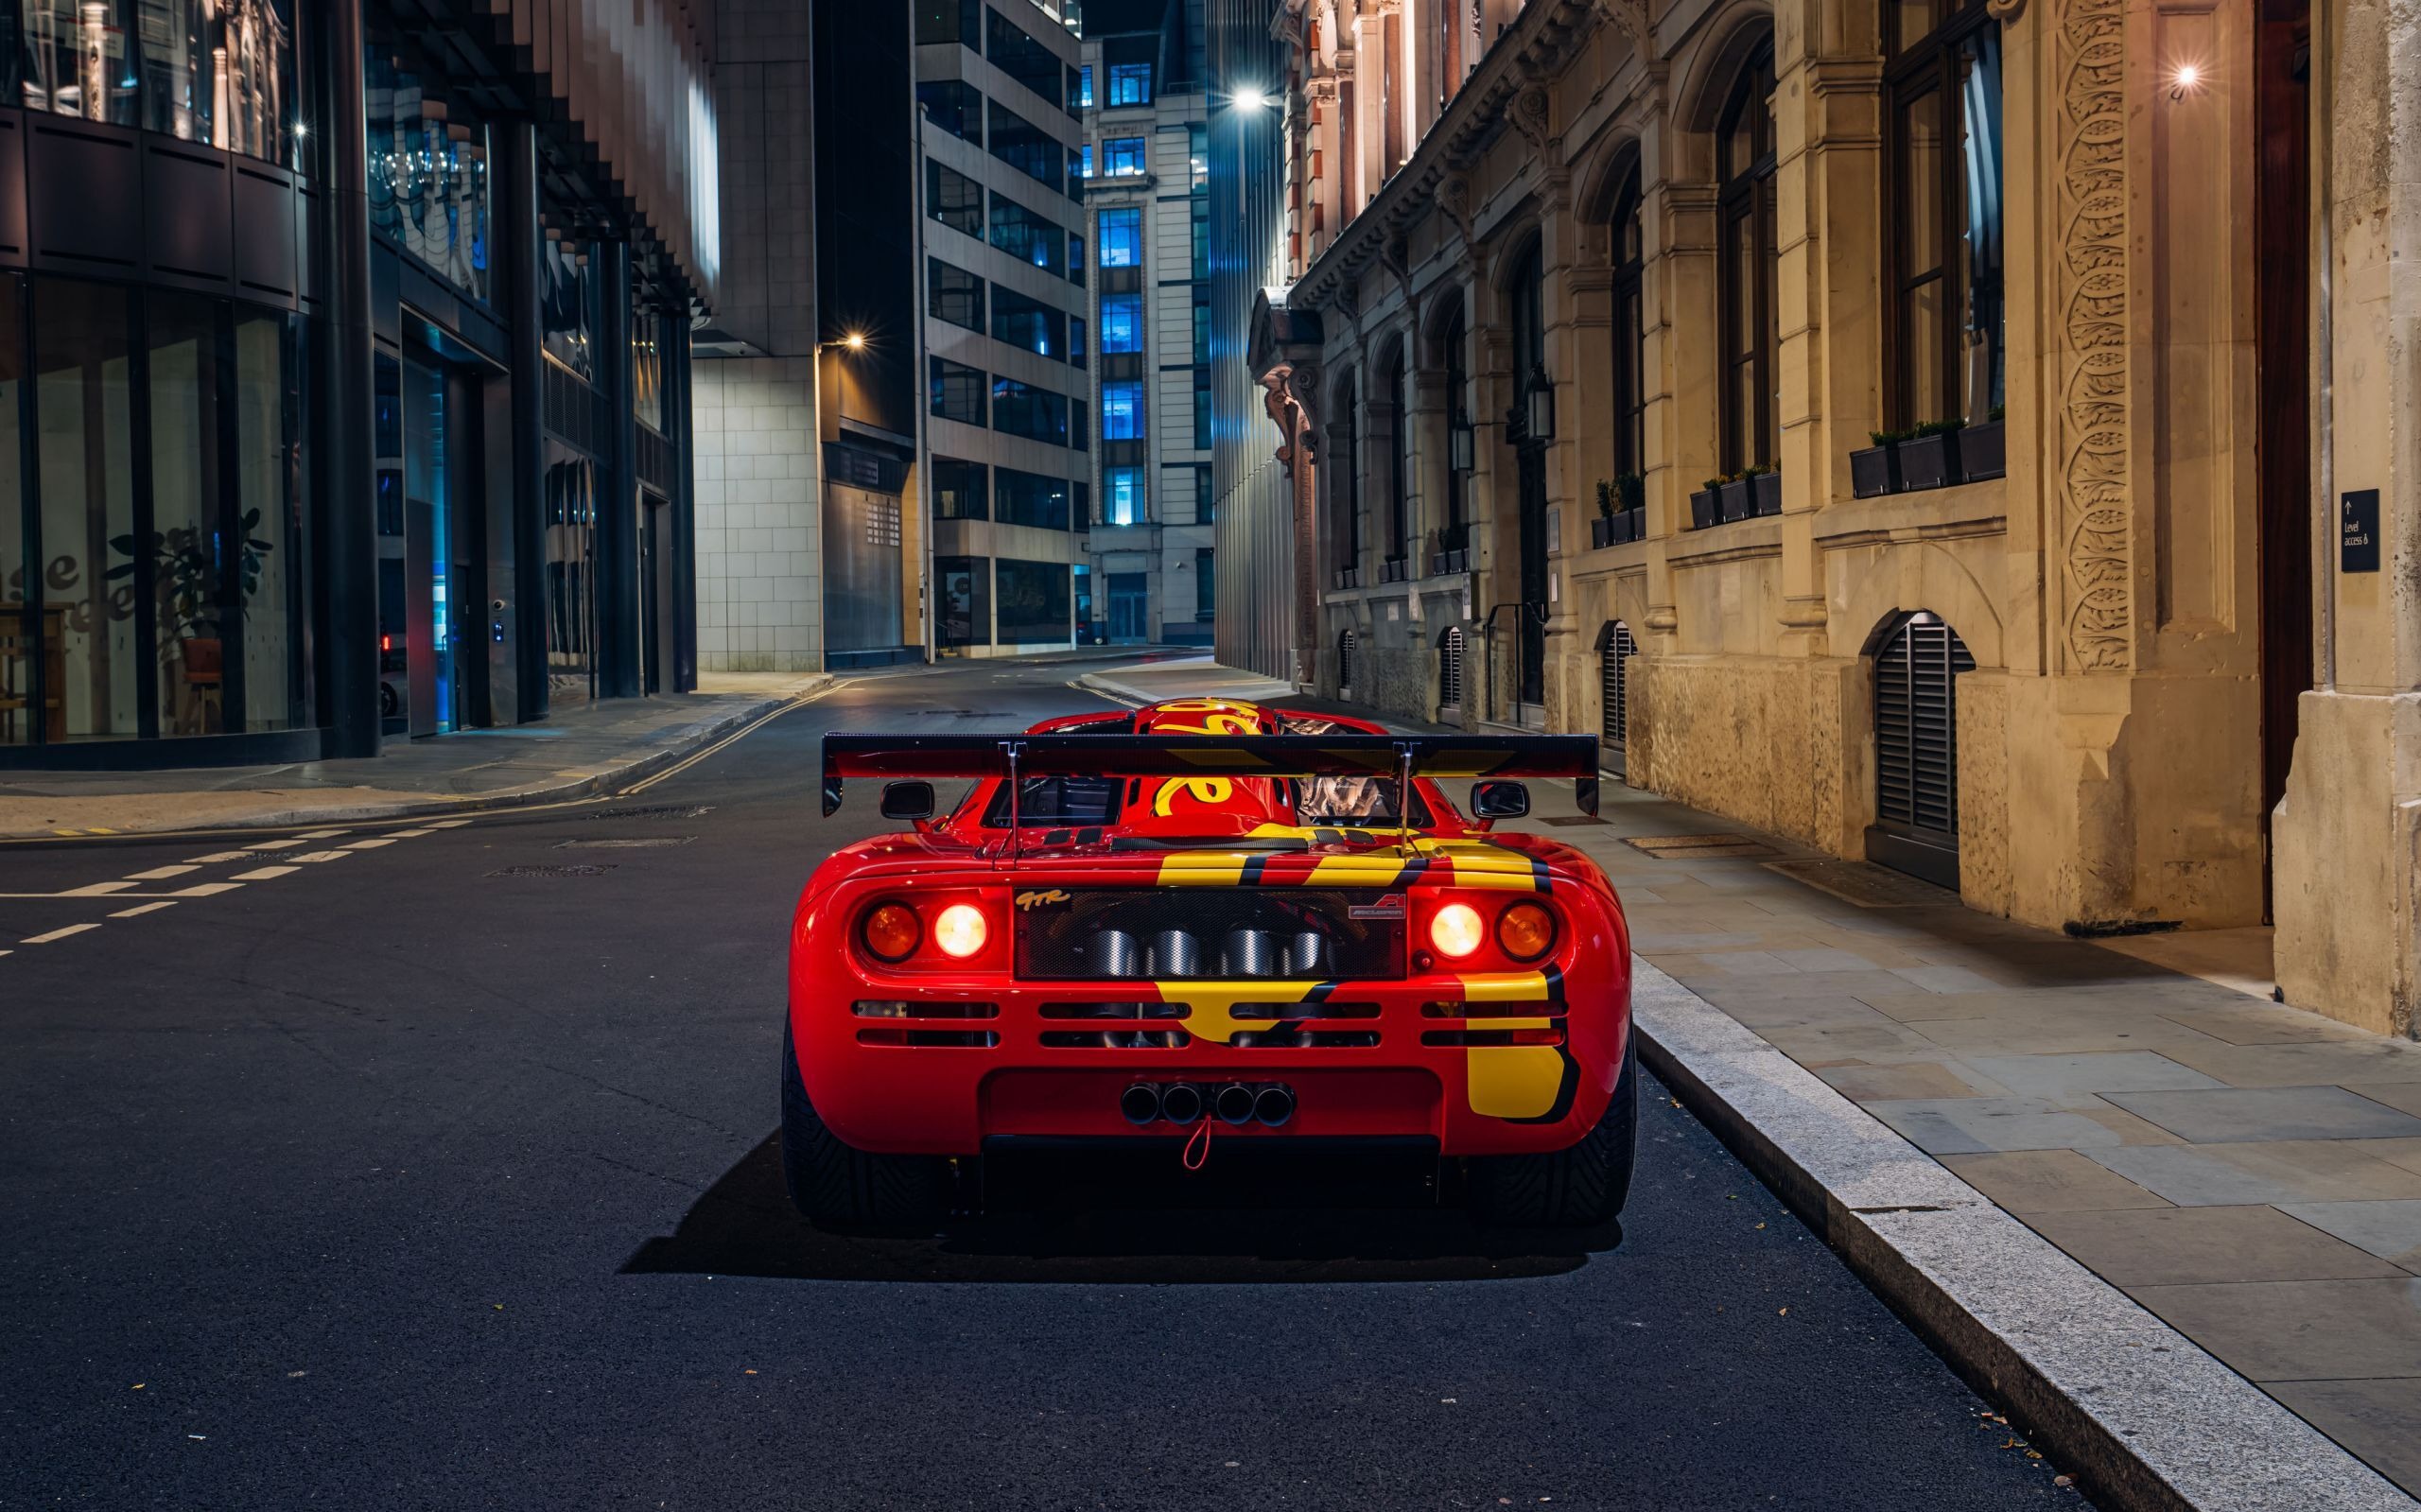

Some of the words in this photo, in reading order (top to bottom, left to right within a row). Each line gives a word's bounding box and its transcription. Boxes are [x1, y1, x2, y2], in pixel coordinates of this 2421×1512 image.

[2344, 520, 2359, 533] Level
[2343, 536, 2362, 547] access
[1016, 889, 1071, 912] GTR
